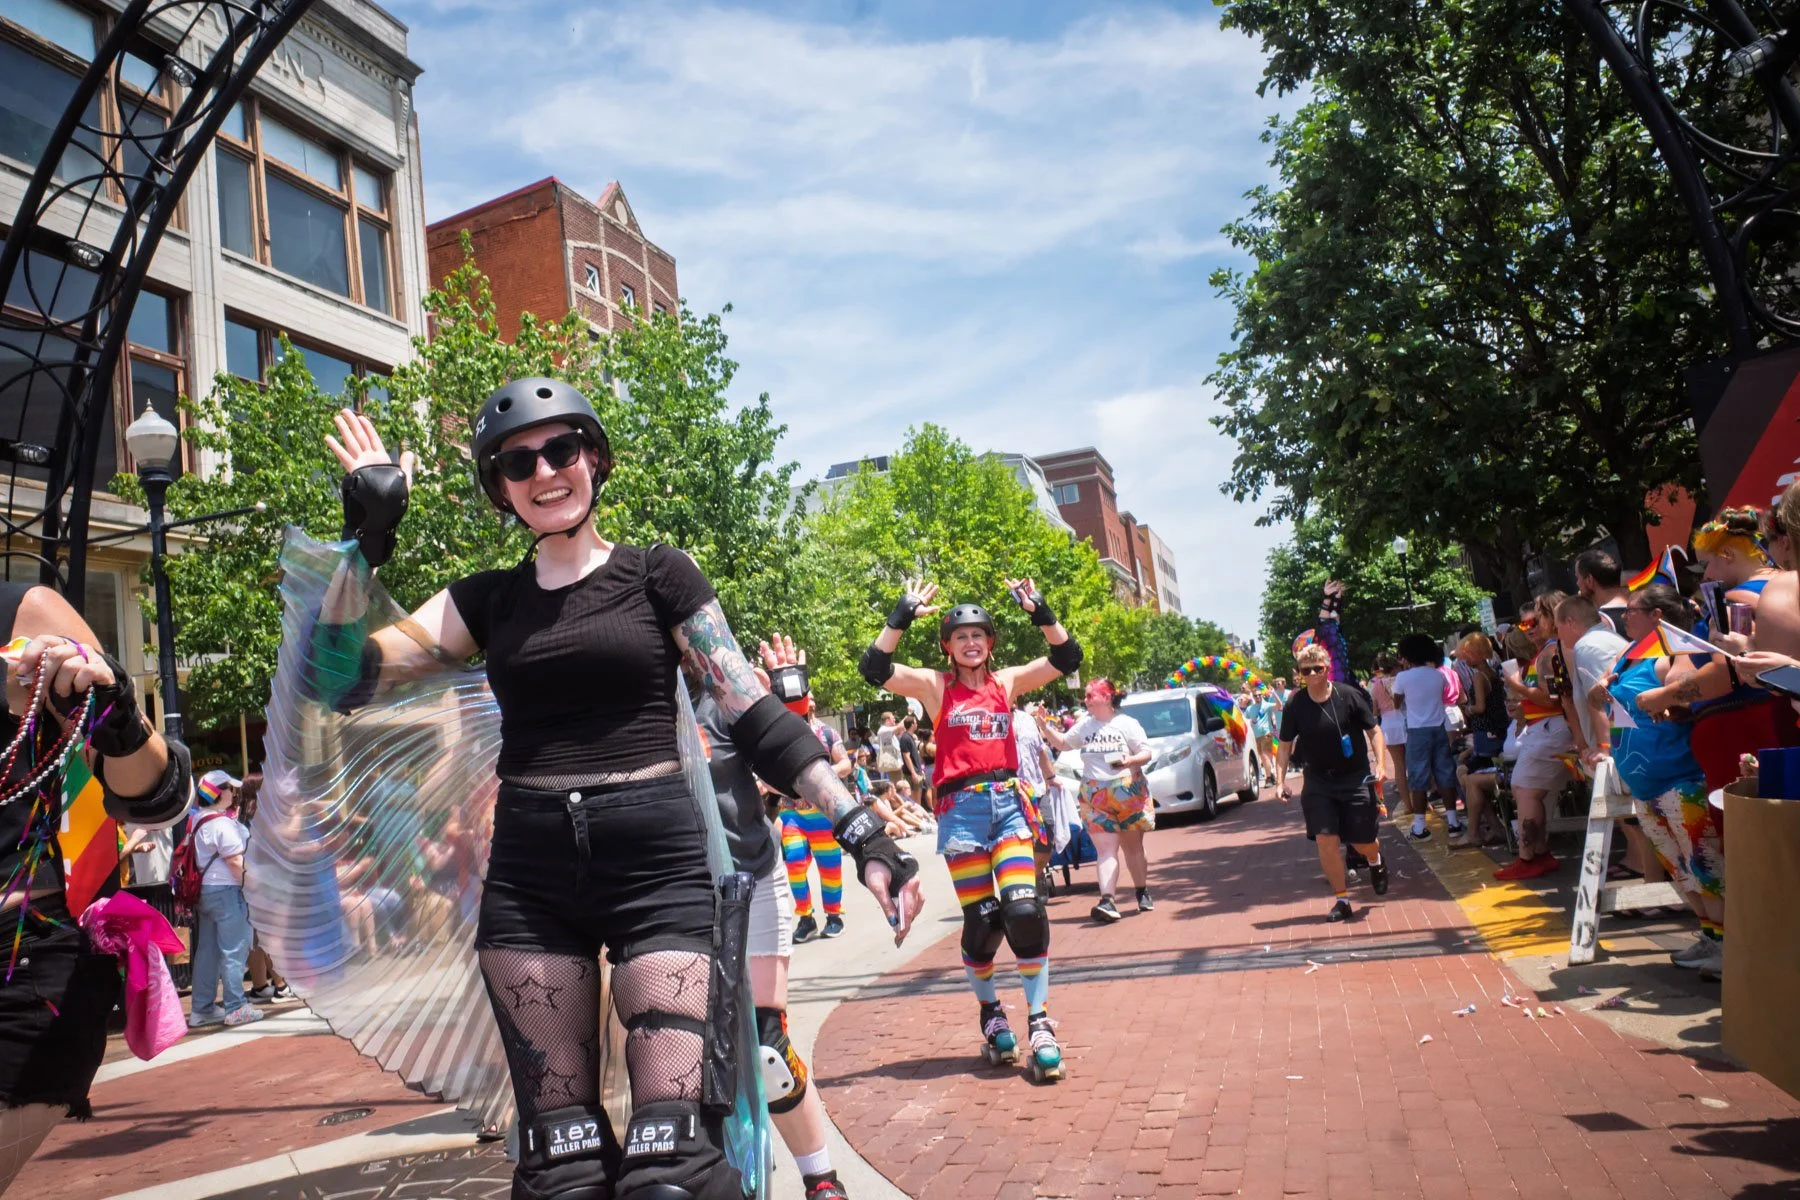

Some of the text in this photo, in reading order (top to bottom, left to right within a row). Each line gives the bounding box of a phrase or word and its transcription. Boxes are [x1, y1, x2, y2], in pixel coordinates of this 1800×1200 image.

[553, 1122, 599, 1144] 187
[630, 1125, 674, 1143] 187
[550, 1136, 601, 1155] KILLER PADS
[627, 1140, 675, 1155] KILLER PADS
